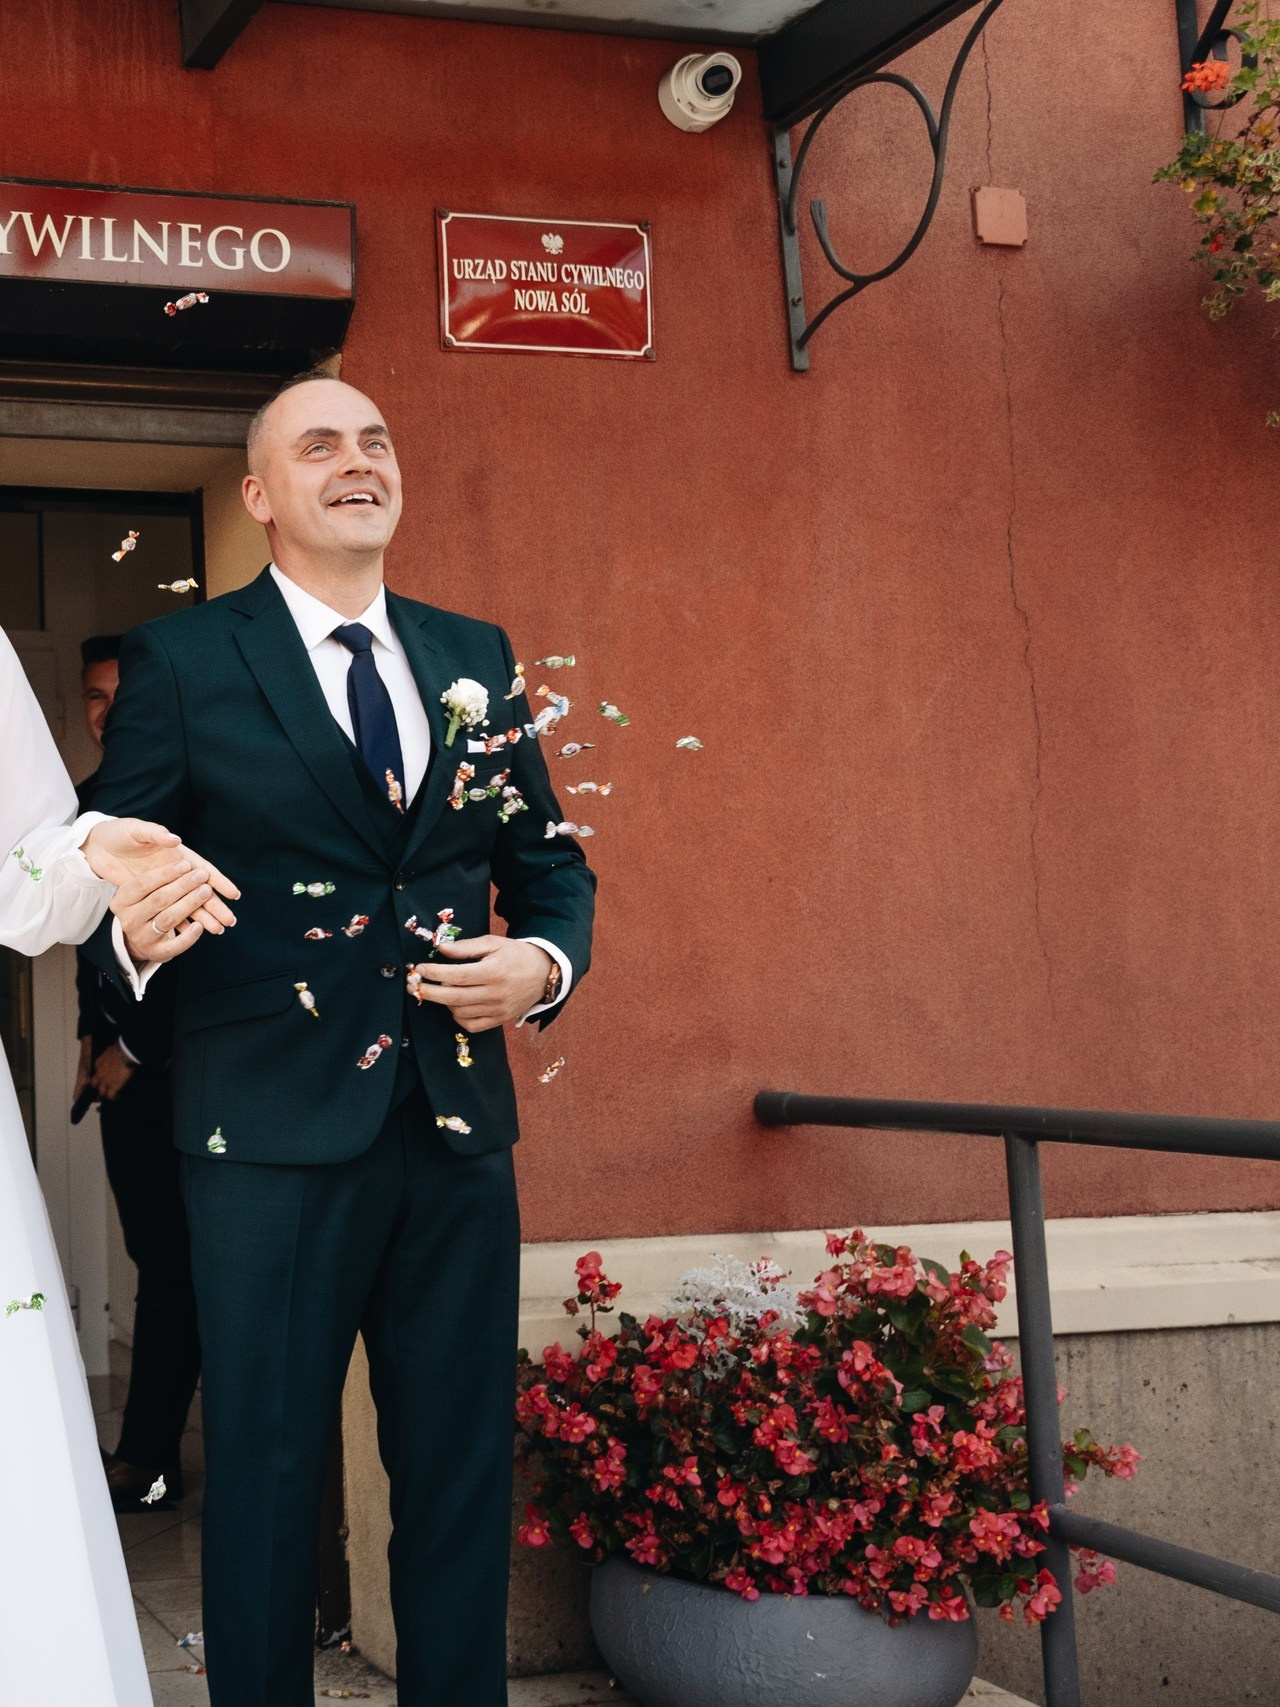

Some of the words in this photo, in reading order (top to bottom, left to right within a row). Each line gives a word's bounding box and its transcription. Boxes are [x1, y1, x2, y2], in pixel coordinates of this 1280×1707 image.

[452, 258, 507, 284] URZĄD
[510, 260, 557, 283] STANU
[561, 263, 644, 291] CYWILNEGO
[514, 289, 558, 313] NOWA
[561, 288, 590, 314] SÓL
